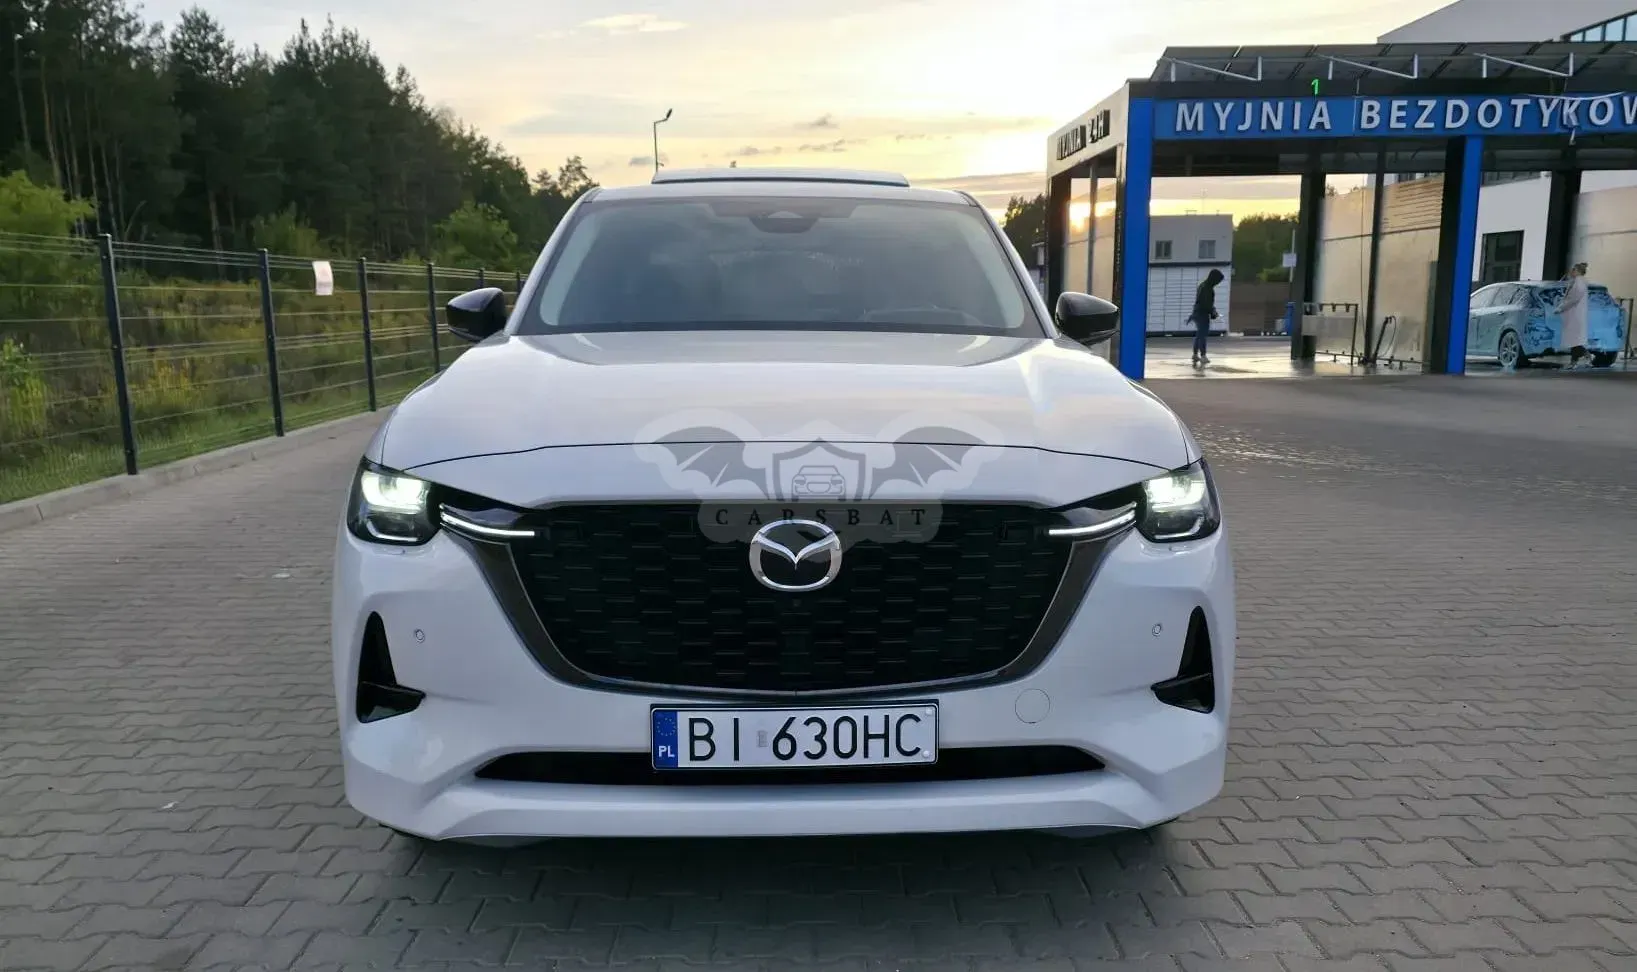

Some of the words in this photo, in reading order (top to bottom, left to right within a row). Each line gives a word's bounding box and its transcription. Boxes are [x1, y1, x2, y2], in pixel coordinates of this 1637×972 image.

[1311, 79, 1320, 95] 1
[1176, 101, 1333, 132] MYJNIA
[688, 717, 740, 762] BI
[772, 713, 922, 761] 630HC
[658, 745, 675, 758] PL
